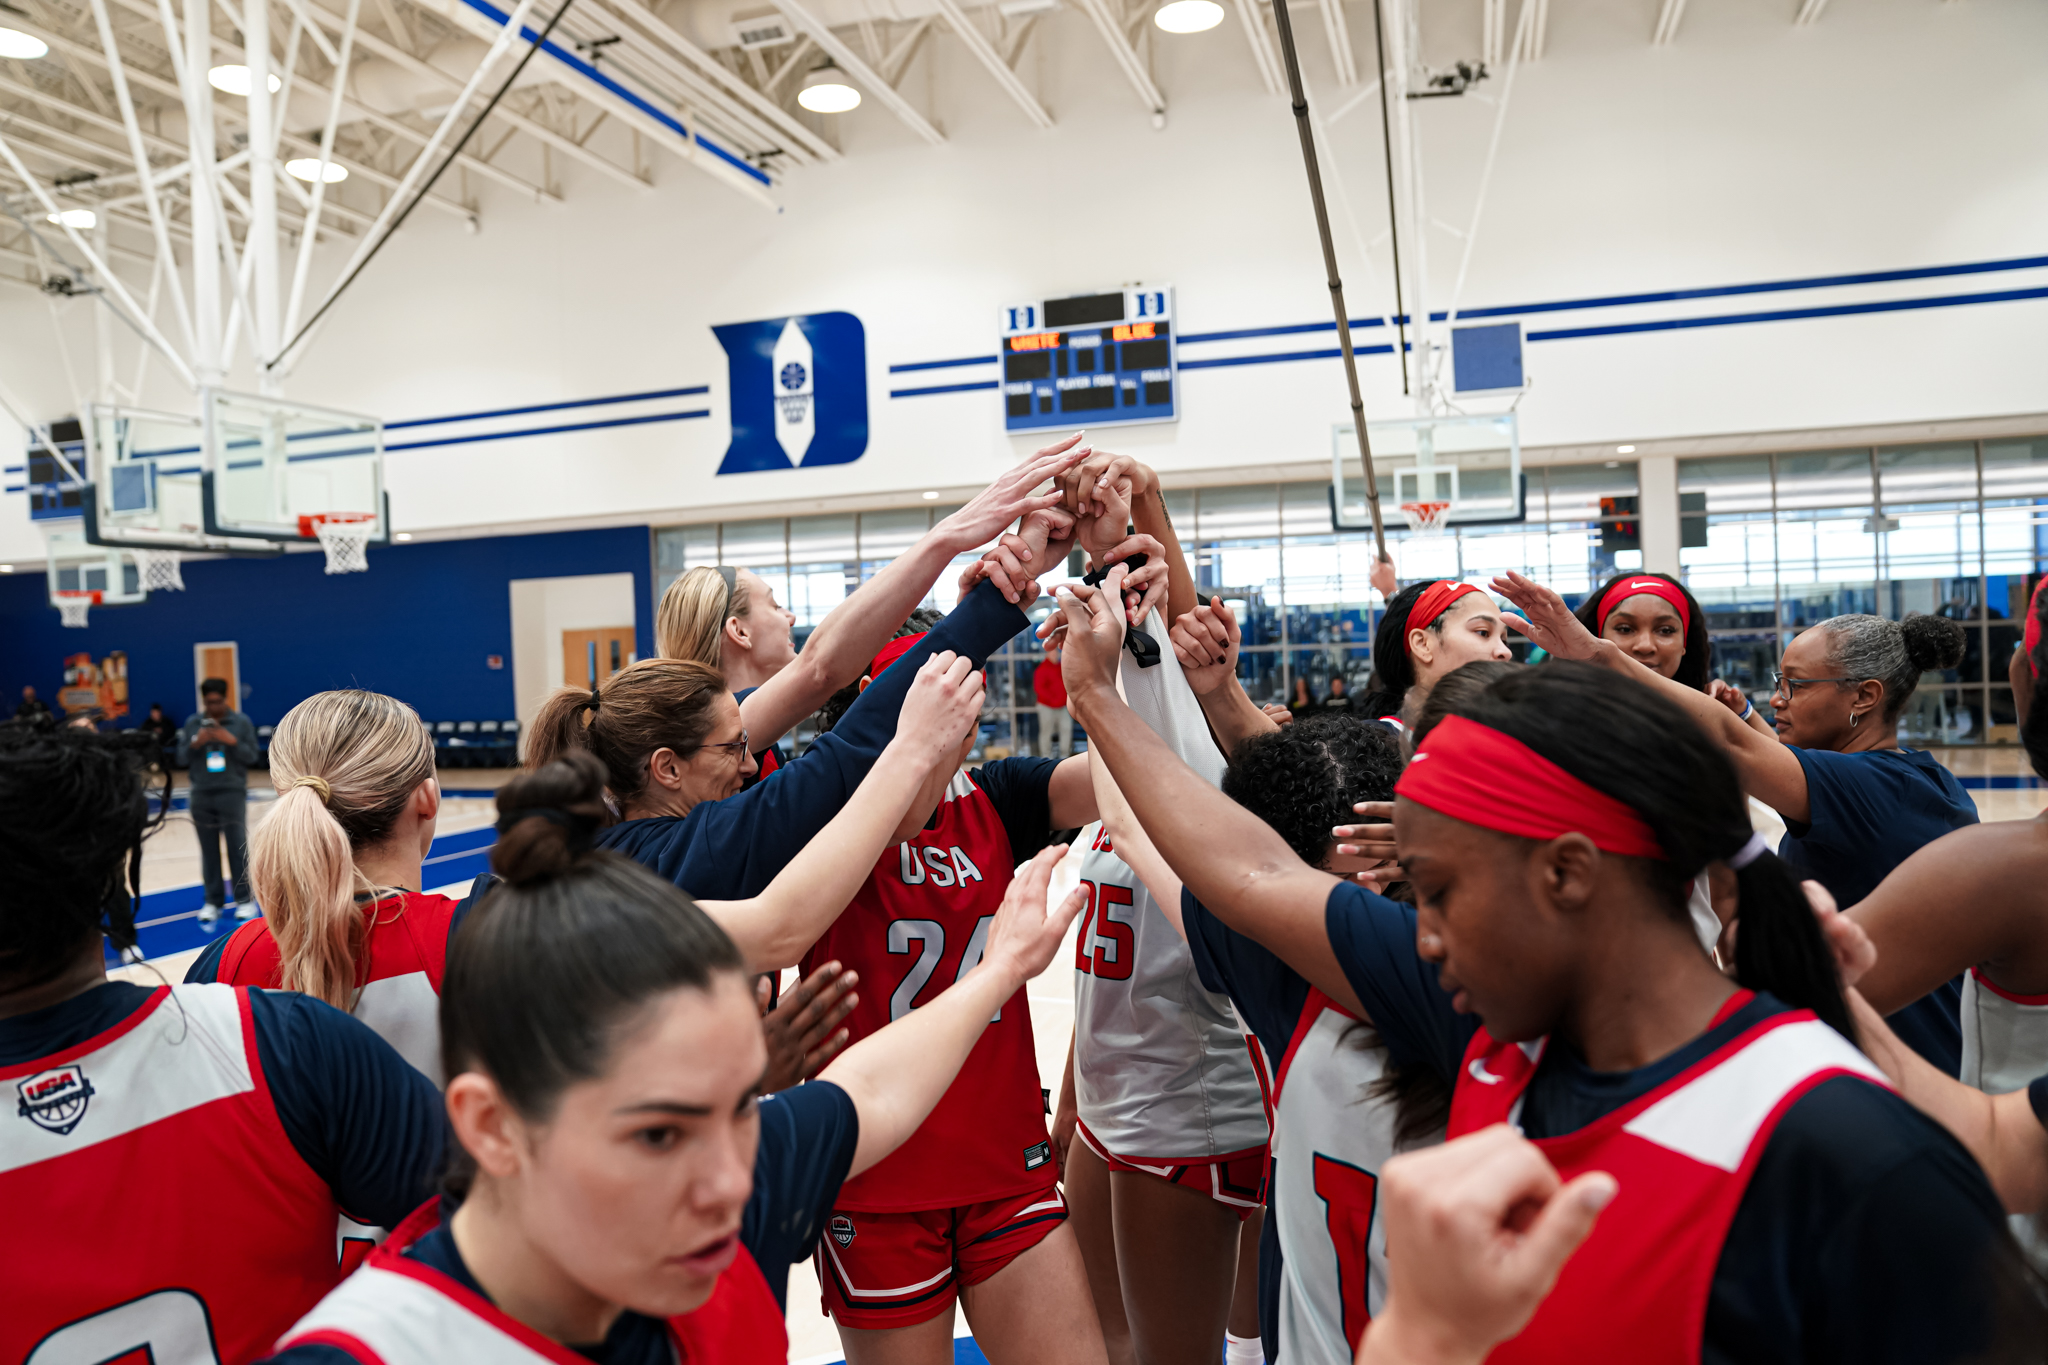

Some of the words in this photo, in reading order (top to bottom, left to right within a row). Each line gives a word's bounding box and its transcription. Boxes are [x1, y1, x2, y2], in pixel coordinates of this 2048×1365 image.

[1011, 332, 1060, 351] WHITE
[1112, 322, 1156, 342] BLUE
[900, 841, 983, 888] USA
[1075, 879, 1135, 981] 25
[25, 1072, 77, 1101] USA
